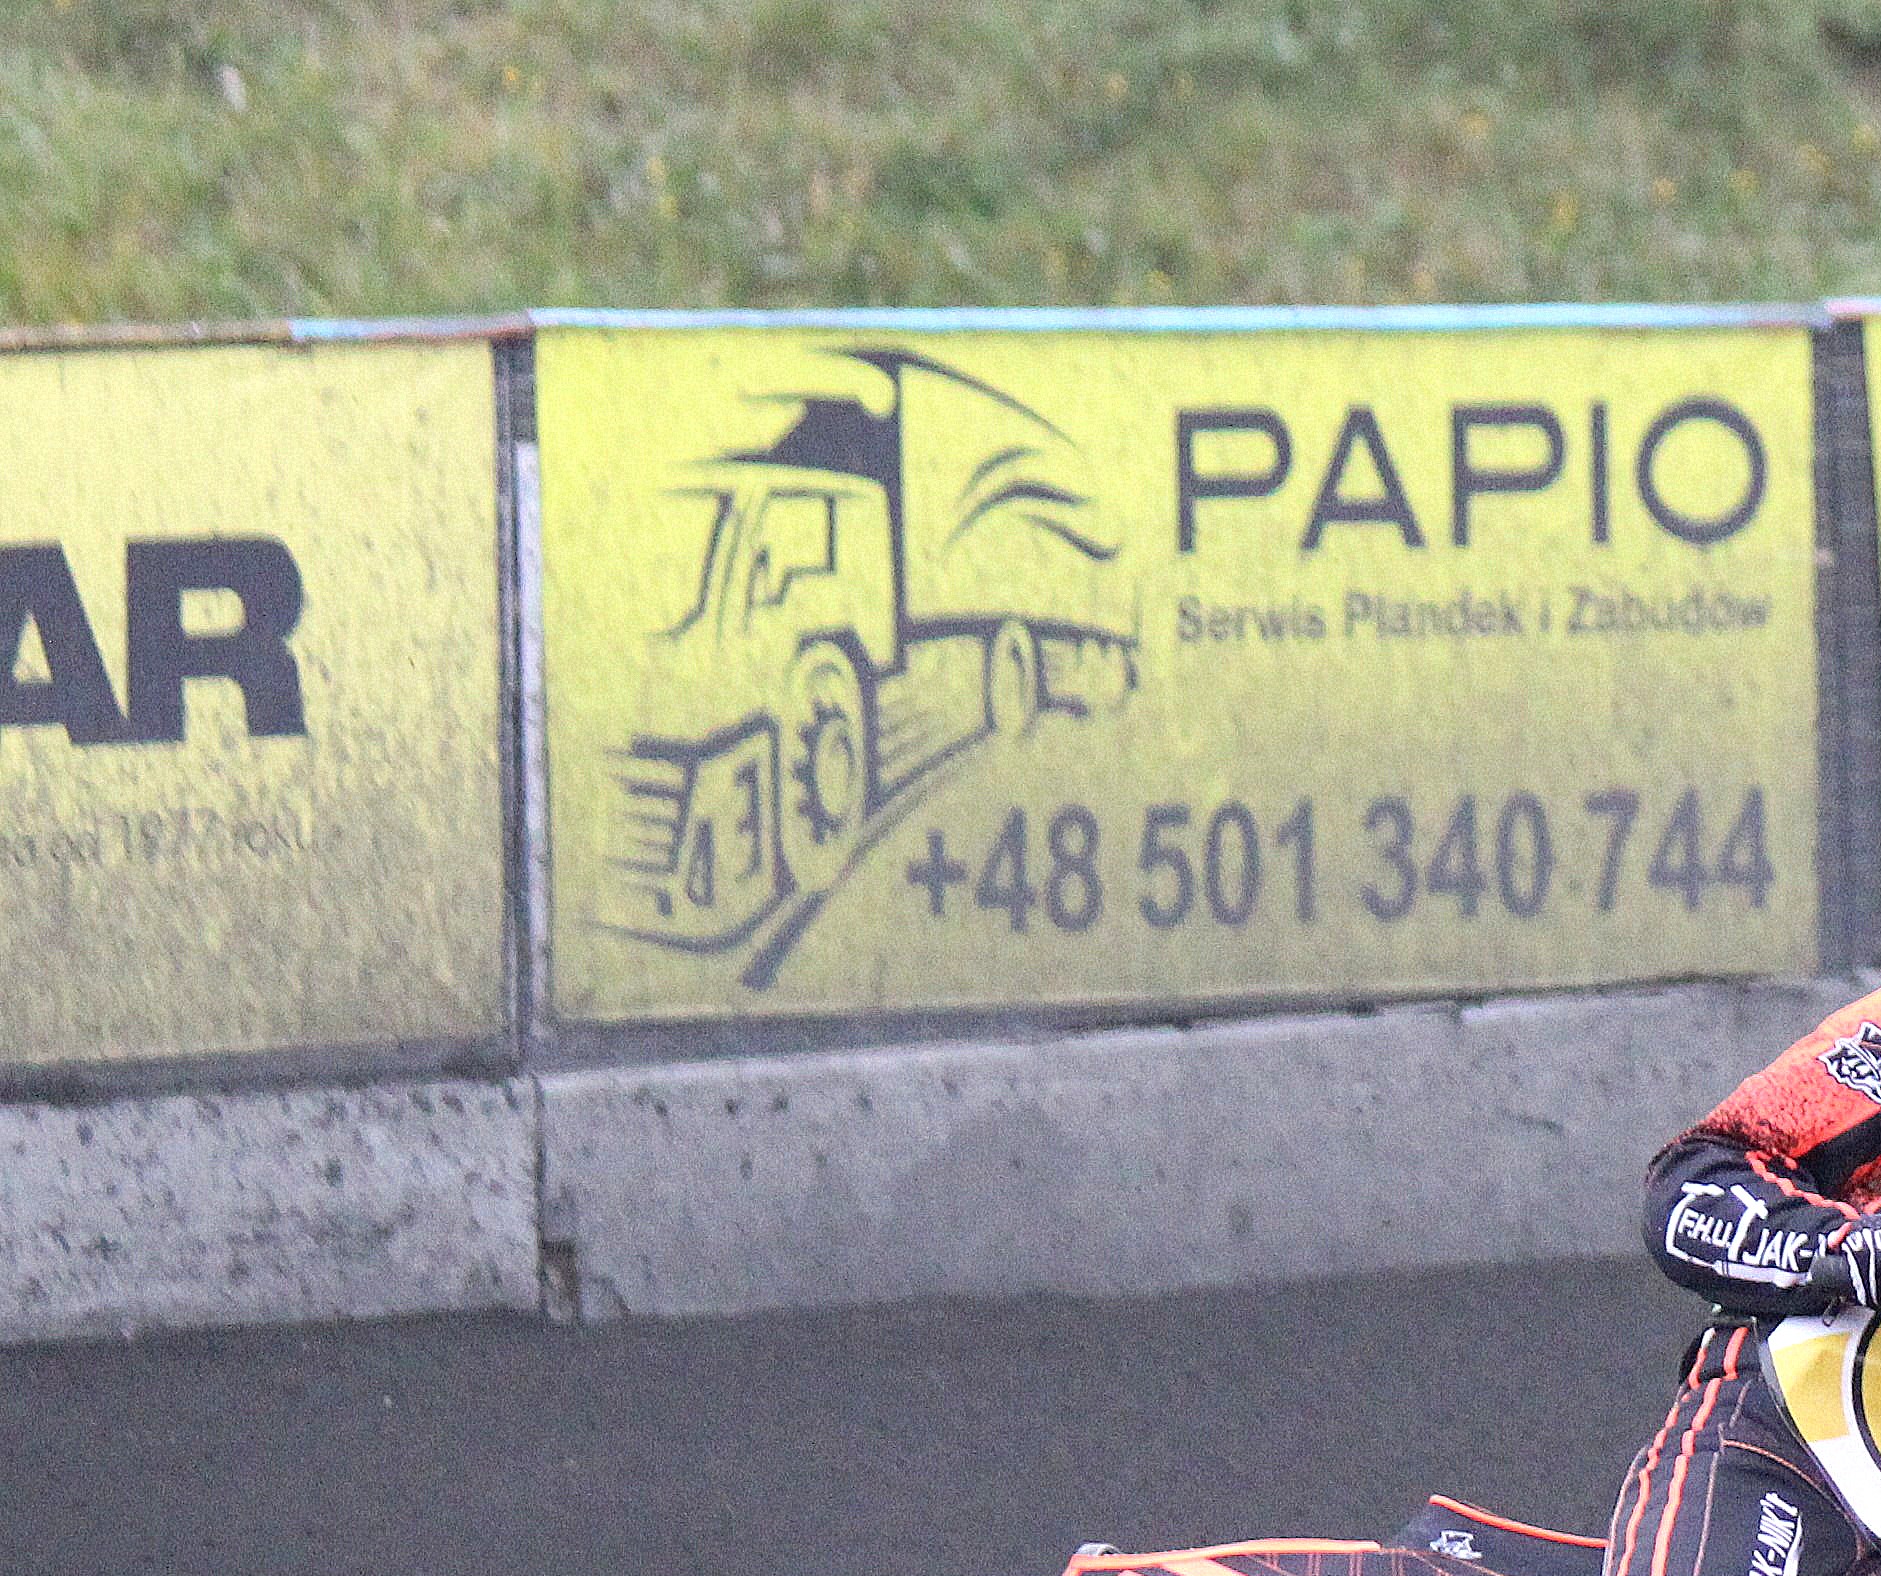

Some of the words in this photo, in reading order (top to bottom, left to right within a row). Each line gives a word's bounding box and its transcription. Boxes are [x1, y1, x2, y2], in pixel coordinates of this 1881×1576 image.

[1174, 395, 1769, 554] PAPIO
[1175, 594, 1327, 644] Serwis
[1344, 590, 1522, 639] Plandek
[1539, 592, 1551, 635] i
[1564, 584, 1772, 635] Zabudów
[906, 803, 1105, 936] +48
[1137, 798, 1317, 931] 501
[1357, 790, 1554, 925] 340
[1580, 784, 1774, 914] 744
